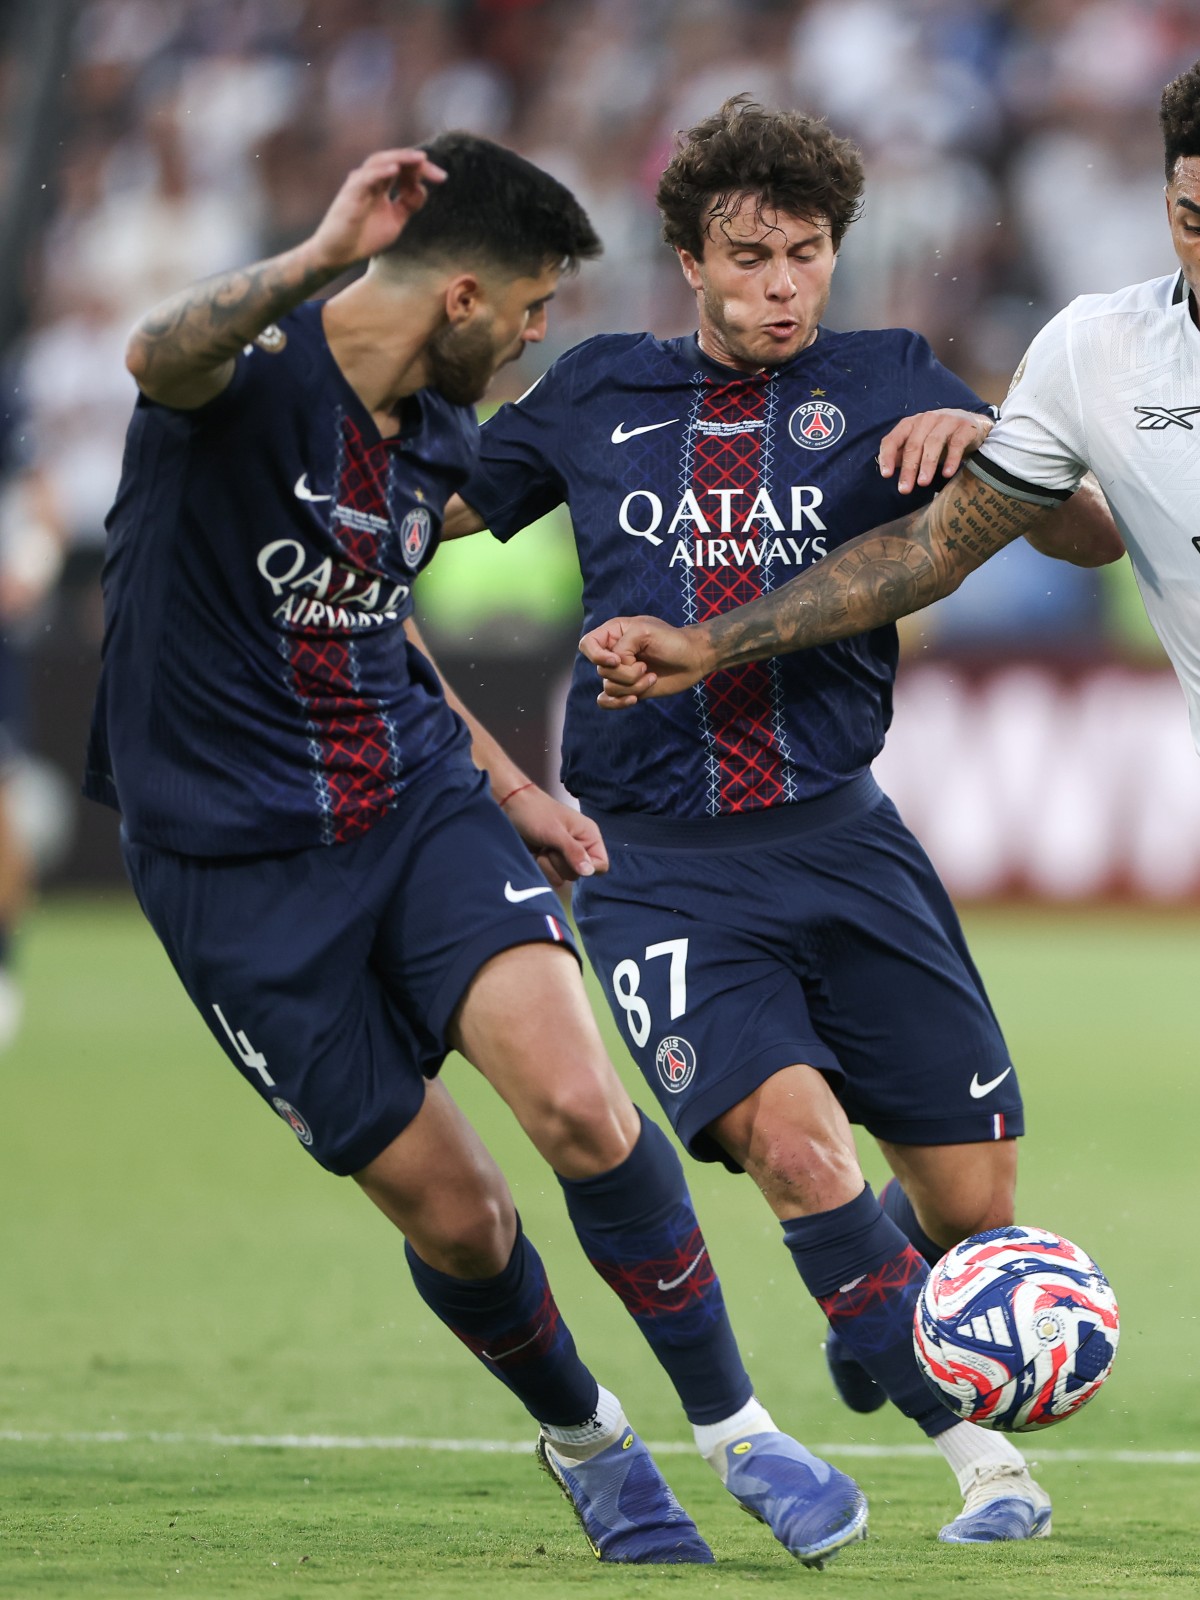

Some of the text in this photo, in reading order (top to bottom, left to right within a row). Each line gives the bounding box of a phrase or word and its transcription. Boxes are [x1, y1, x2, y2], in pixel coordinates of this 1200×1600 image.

[798, 403, 836, 416] PARIS
[618, 485, 828, 546] QATAR
[668, 536, 828, 568] AIRWAYS
[612, 938, 689, 1048] 87
[212, 1003, 276, 1087] 4
[658, 1039, 679, 1062] PARIS
